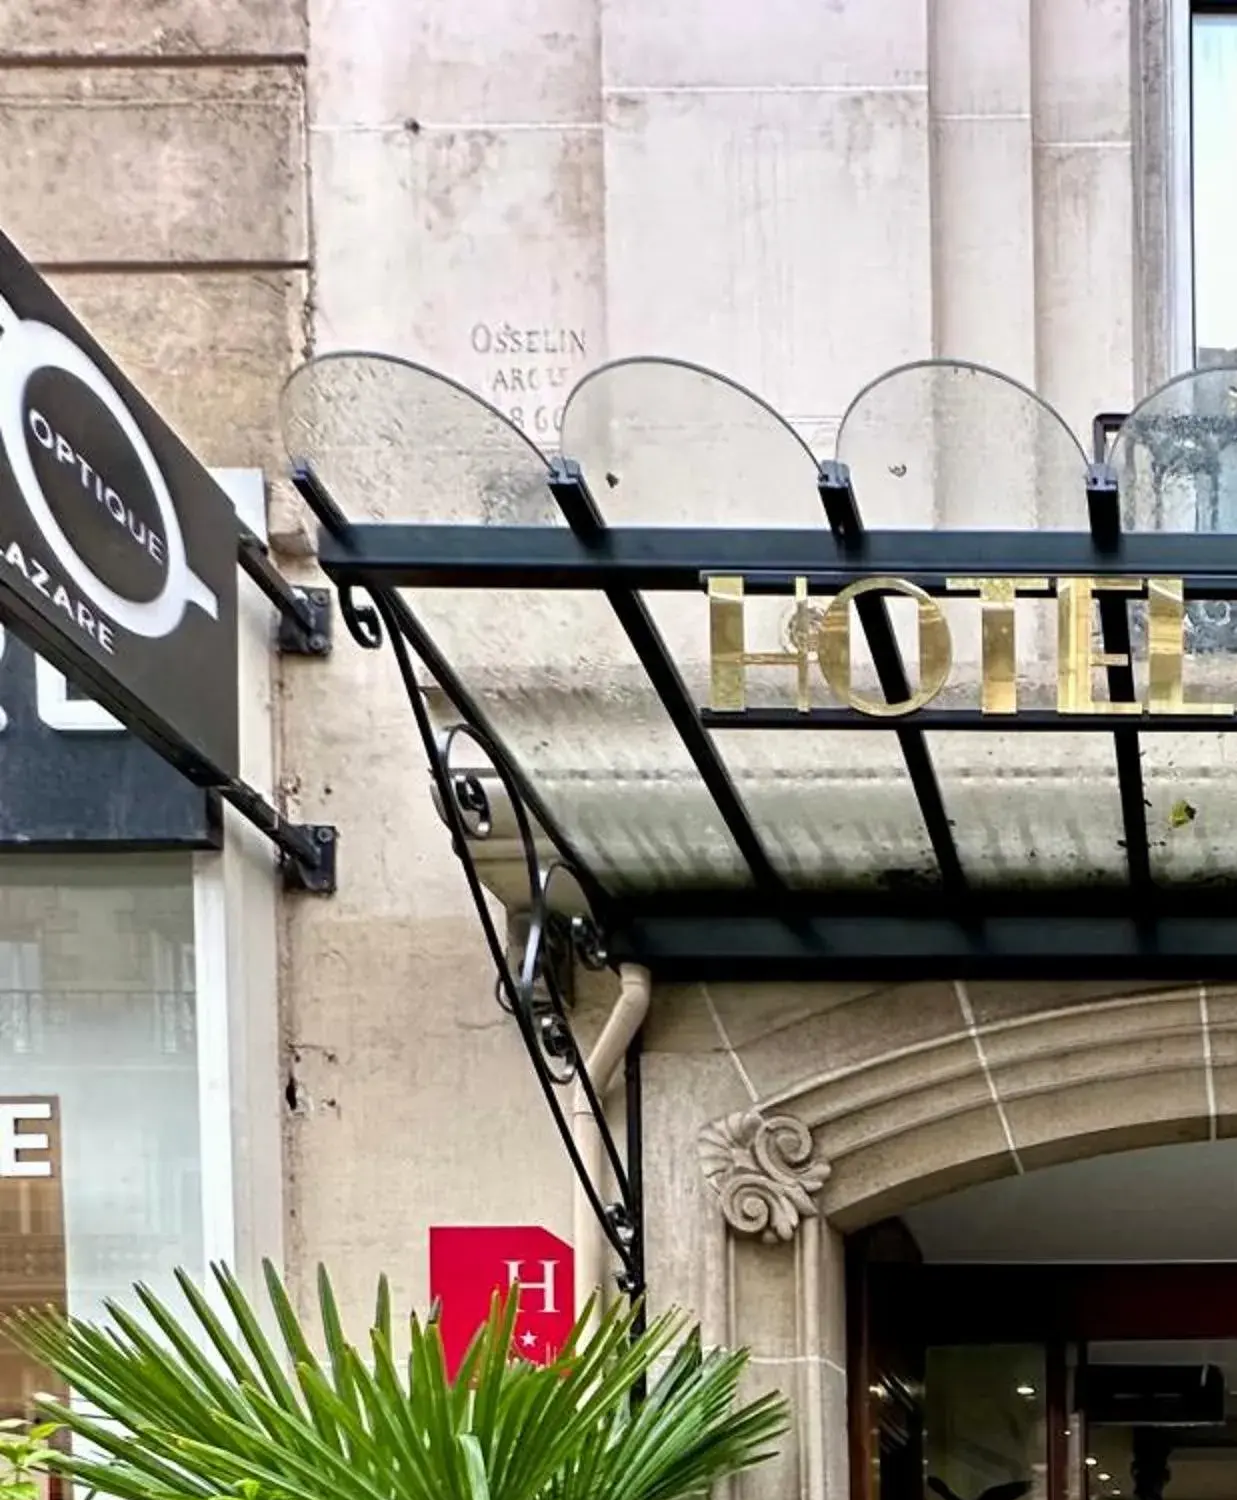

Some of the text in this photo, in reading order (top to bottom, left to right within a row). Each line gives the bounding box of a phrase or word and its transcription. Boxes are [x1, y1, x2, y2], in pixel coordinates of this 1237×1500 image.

[471, 323, 587, 358] OSSELIN
[29, 408, 165, 565] OPTIQUE
[0, 541, 116, 656] AZARE
[707, 575, 1235, 719] HOTEL
[502, 1260, 561, 1313] H
